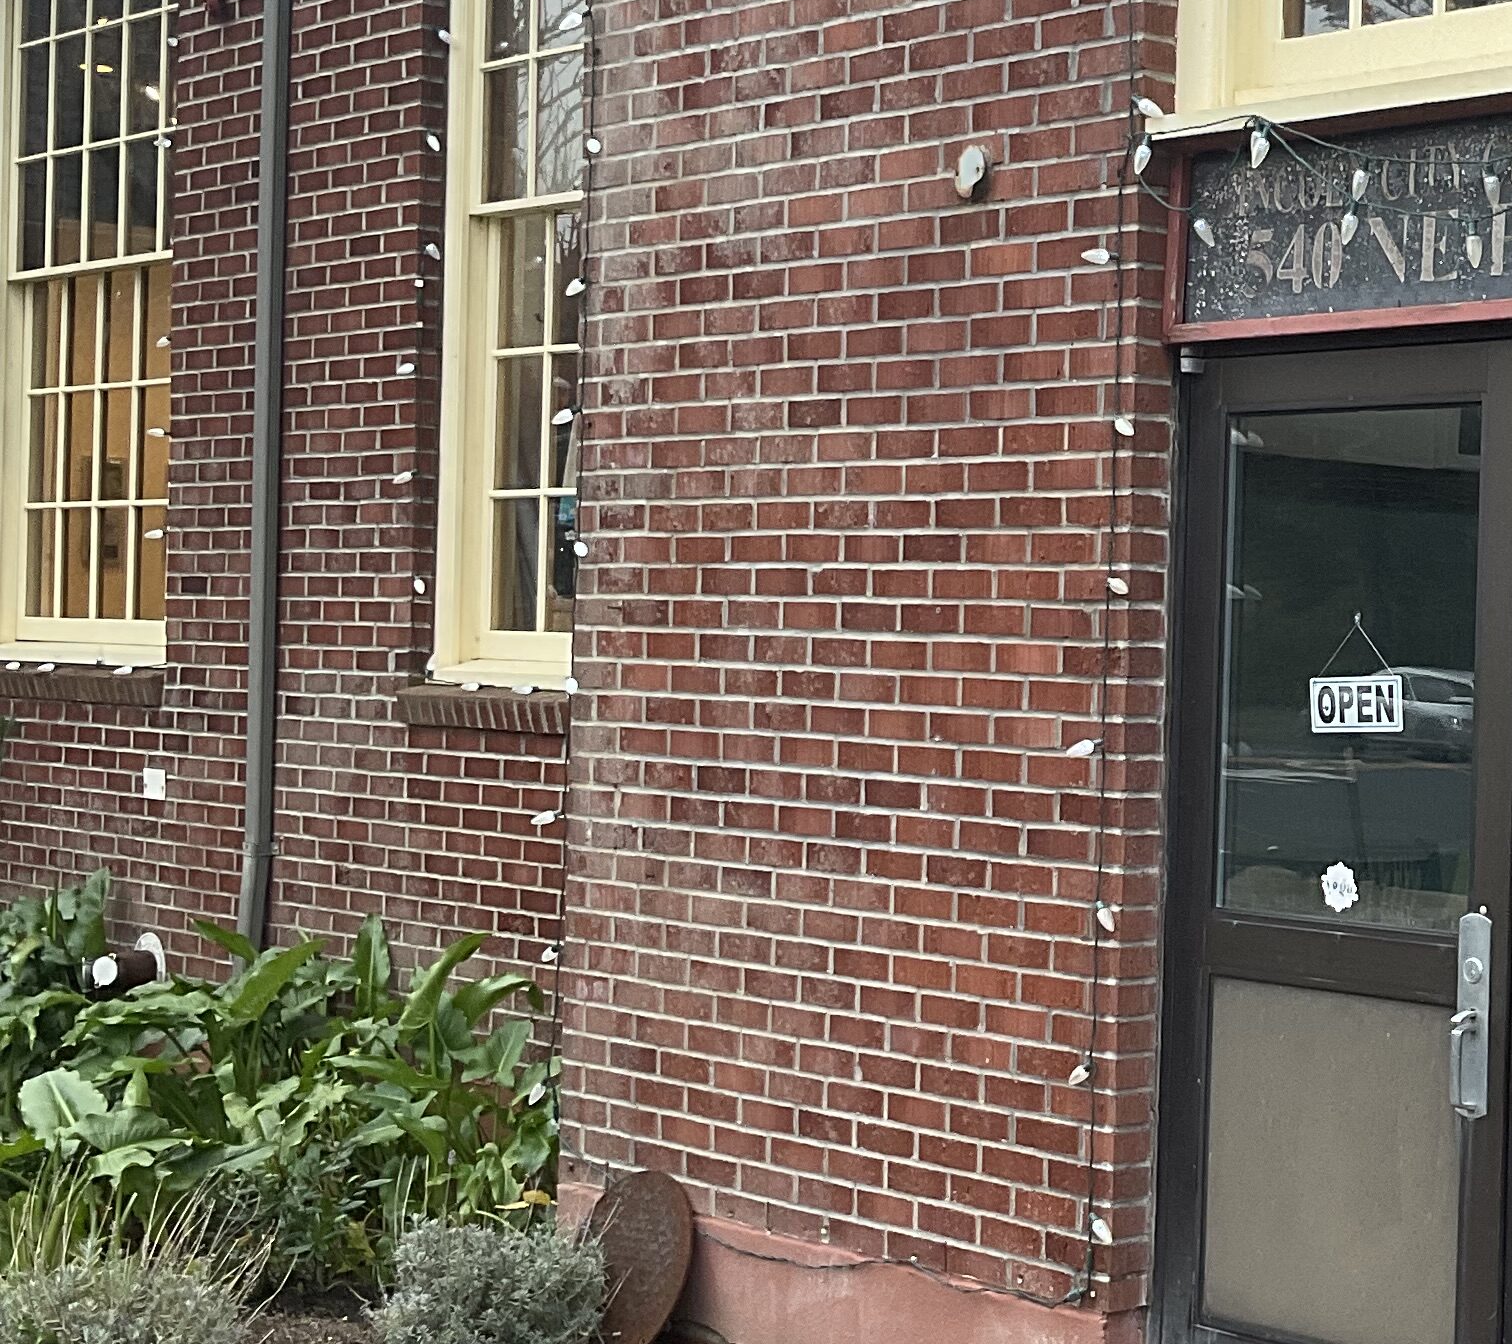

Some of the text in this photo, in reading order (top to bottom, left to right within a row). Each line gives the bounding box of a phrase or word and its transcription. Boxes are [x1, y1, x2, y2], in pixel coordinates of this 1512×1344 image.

[1248, 221, 1344, 294] 540
[1368, 209, 1459, 284] NE
[1317, 685, 1395, 724] OPEN
